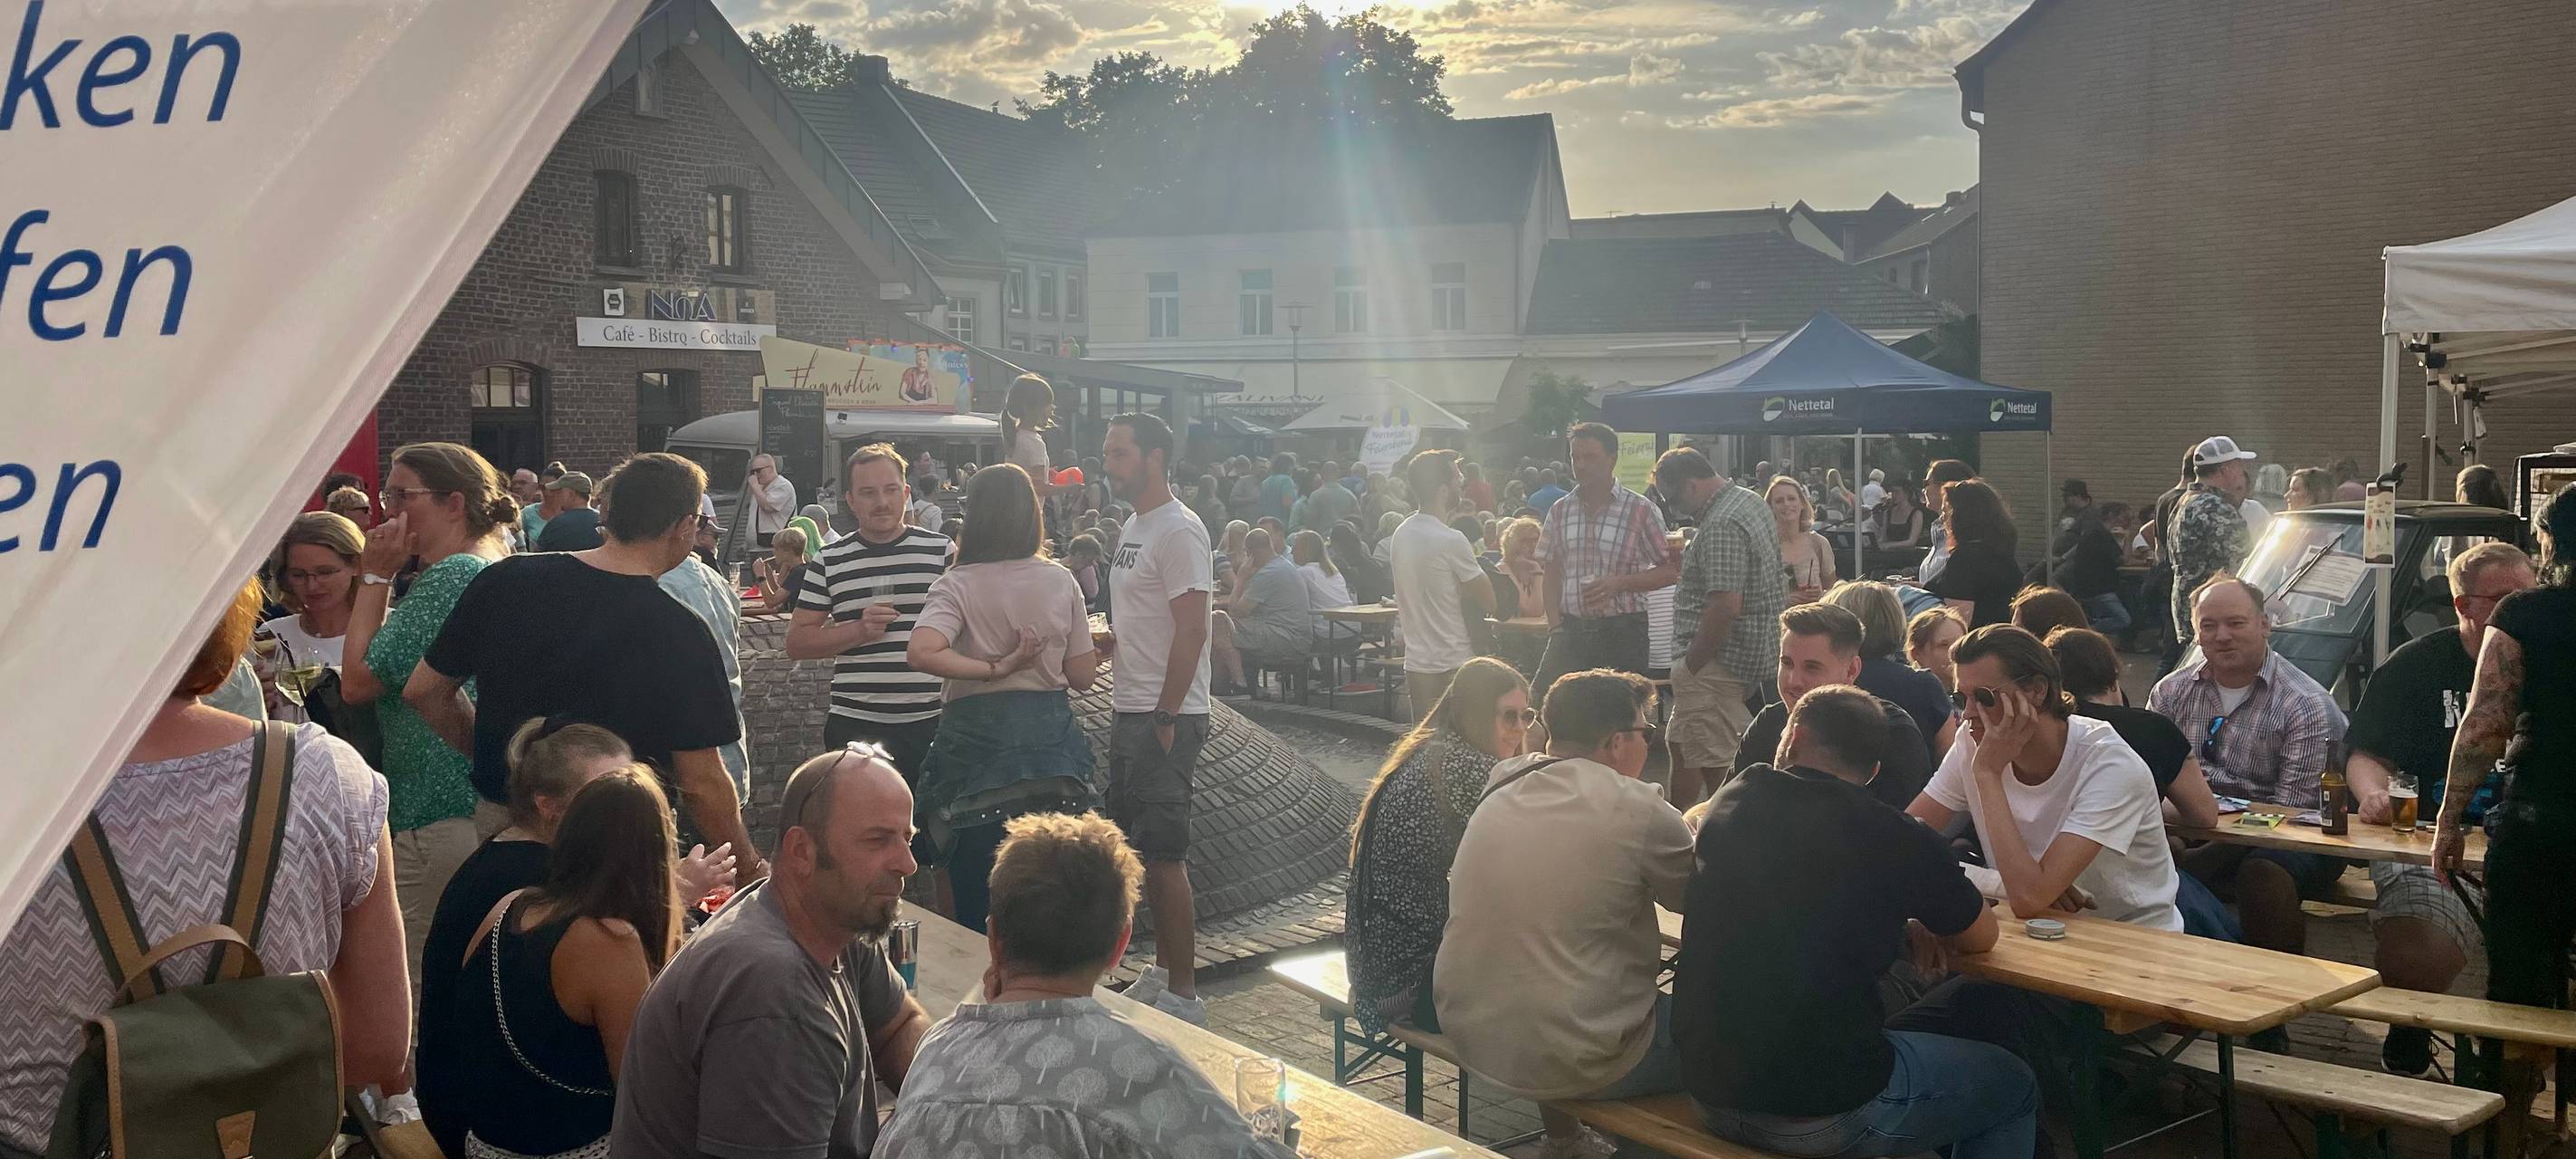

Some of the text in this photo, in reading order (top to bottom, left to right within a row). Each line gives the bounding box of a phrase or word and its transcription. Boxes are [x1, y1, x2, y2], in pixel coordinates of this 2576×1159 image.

[0, 0, 241, 130] ken
[603, 325, 634, 341] Café
[649, 327, 688, 344] Bistro
[700, 329, 758, 346] Cocktails
[1789, 397, 1836, 411] Nettetal
[2007, 402, 2037, 414] Nettetal
[0, 459, 122, 553] en
